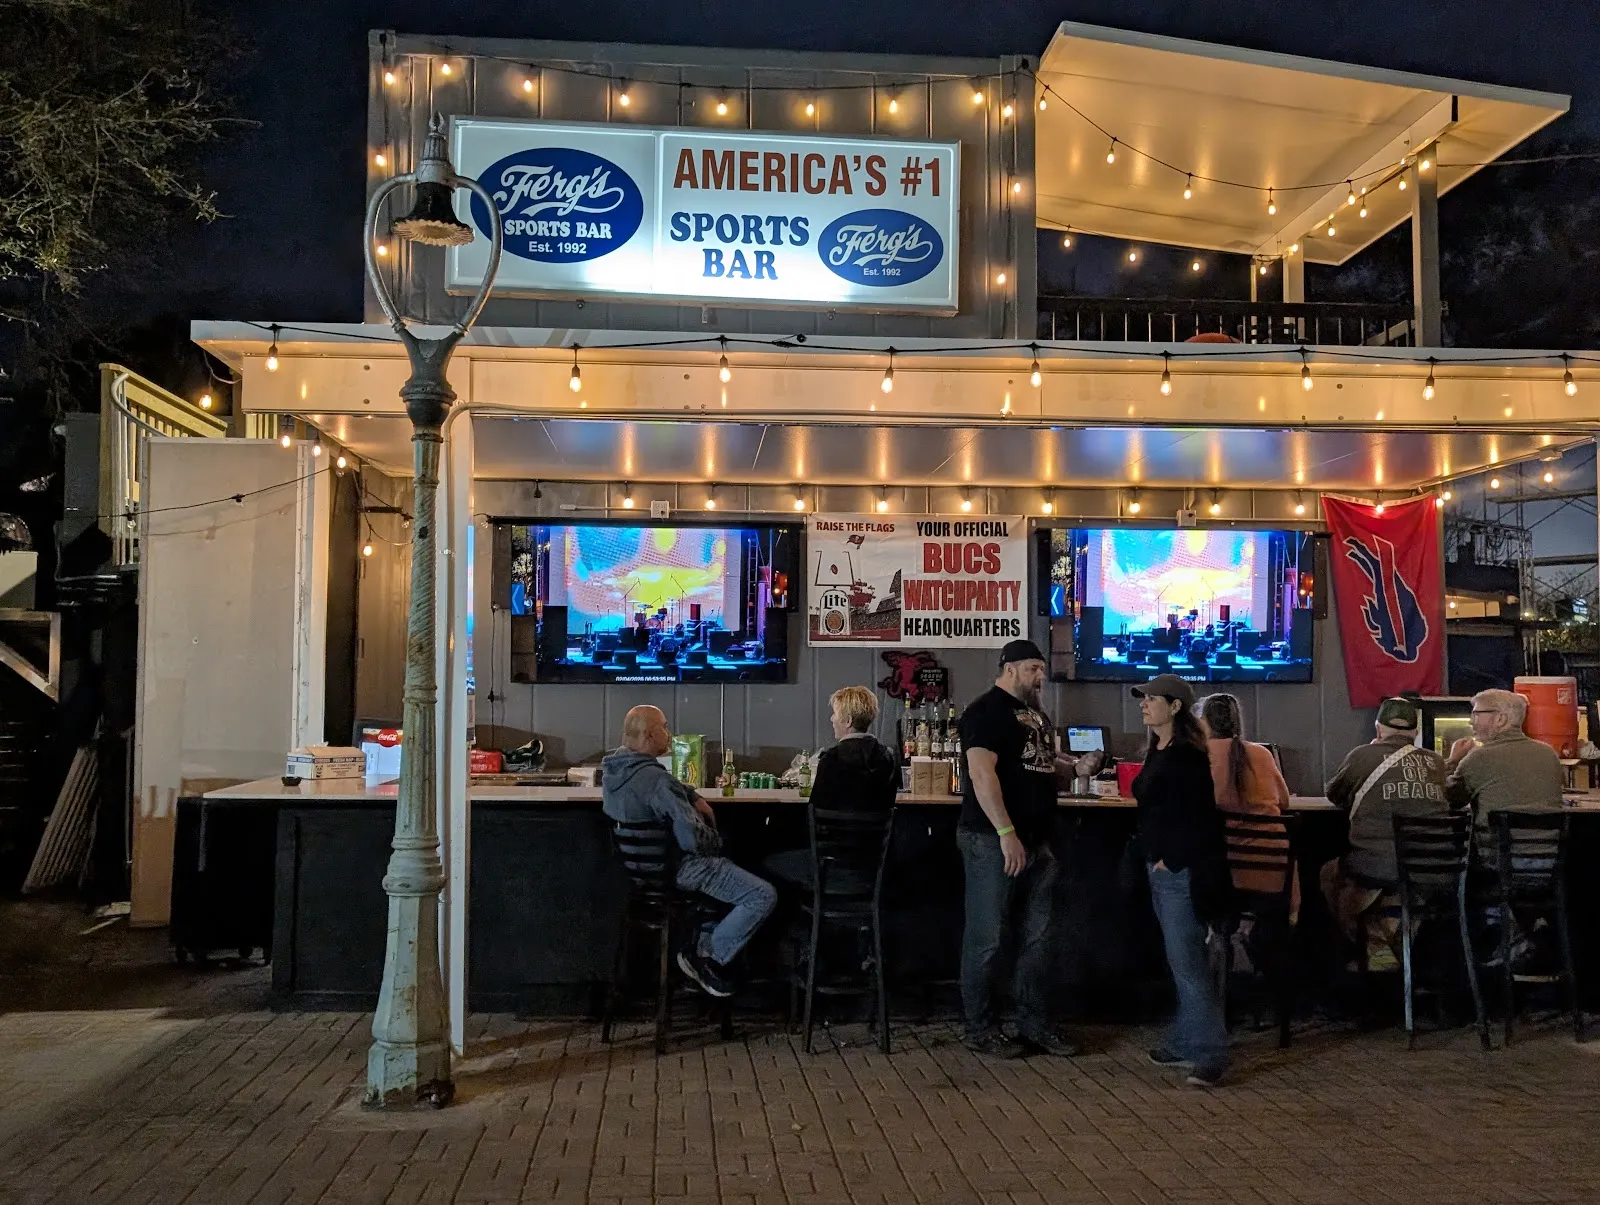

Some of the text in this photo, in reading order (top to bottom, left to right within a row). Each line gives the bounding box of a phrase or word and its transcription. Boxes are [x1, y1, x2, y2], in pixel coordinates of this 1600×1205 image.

[673, 148, 940, 197] AMERICA'S #1
[493, 165, 624, 216] Ferg's
[504, 219, 613, 239] SPORTS BAR
[670, 211, 810, 246] SPORTS
[528, 241, 587, 254] Est. 1992
[829, 223, 933, 266] Ferg's
[702, 248, 779, 280] BAR
[863, 268, 901, 276] Est. 1992
[816, 521, 895, 532] RAISE THE FLAGS
[916, 521, 1009, 537] YOUR OFFICIAL
[923, 542, 1001, 574] BUCS
[823, 594, 847, 610] Lite
[903, 579, 1022, 612] WATCHPARTY
[903, 617, 1021, 638] HEADQUARTERS
[1403, 766, 1427, 783] OF
